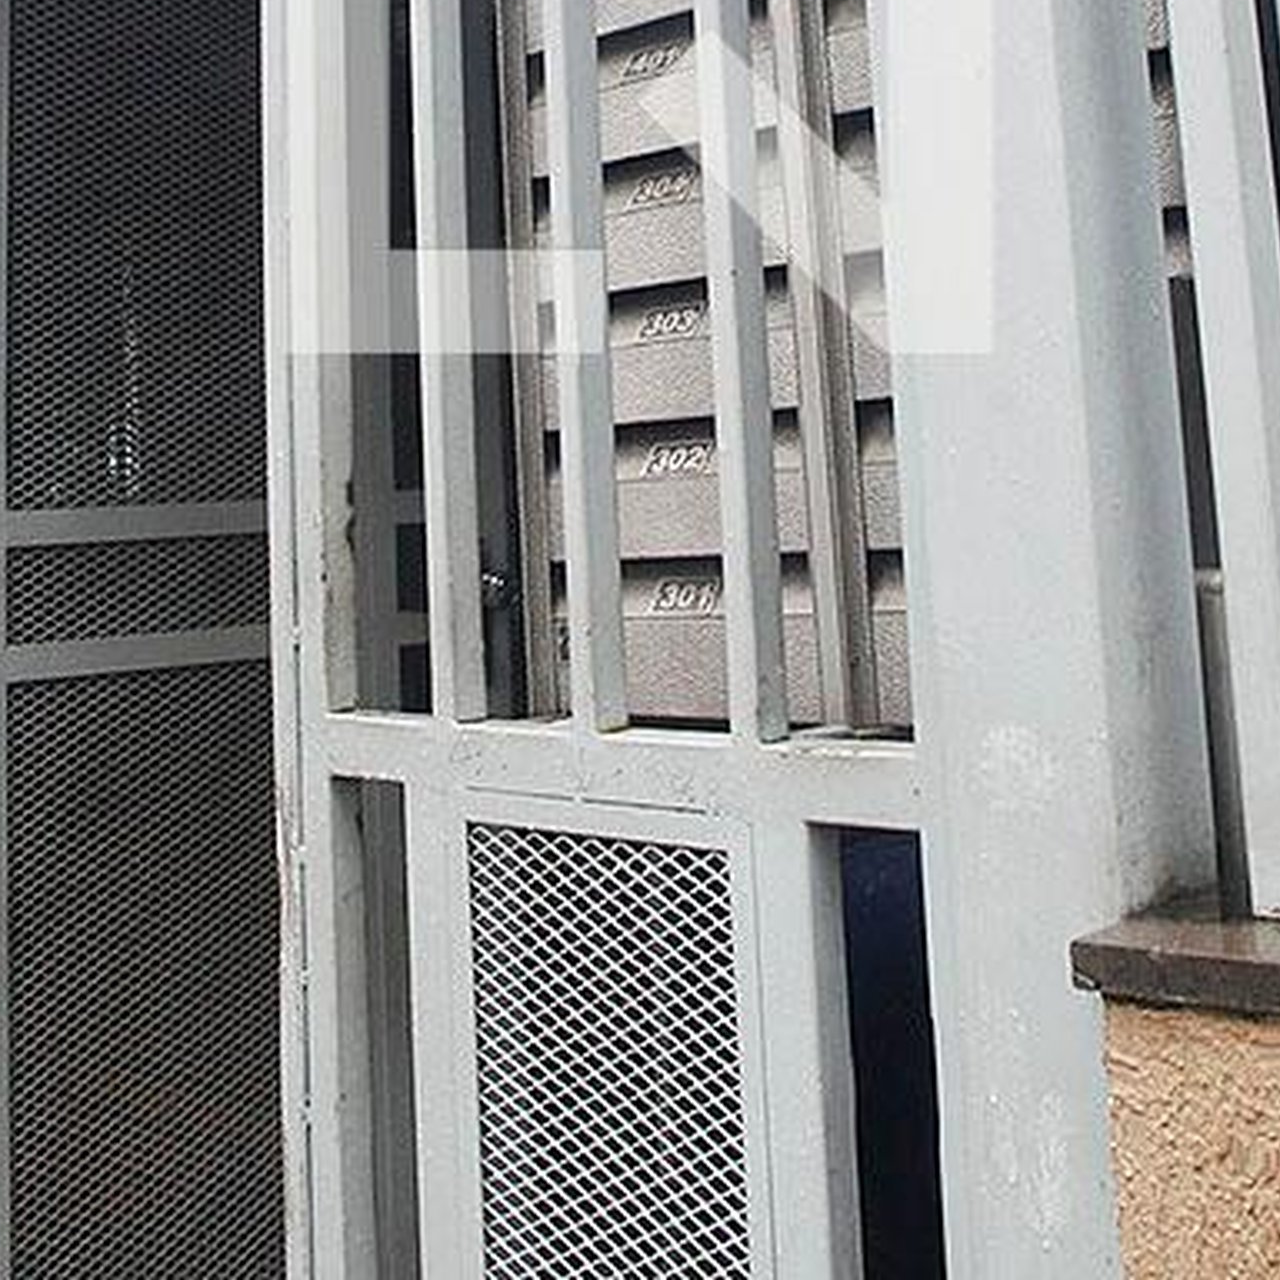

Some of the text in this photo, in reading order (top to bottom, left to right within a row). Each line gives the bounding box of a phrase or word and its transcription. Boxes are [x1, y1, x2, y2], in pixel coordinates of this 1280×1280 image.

[642, 308, 699, 337] 303
[650, 446, 704, 474] 302
[656, 583, 715, 612] 301
